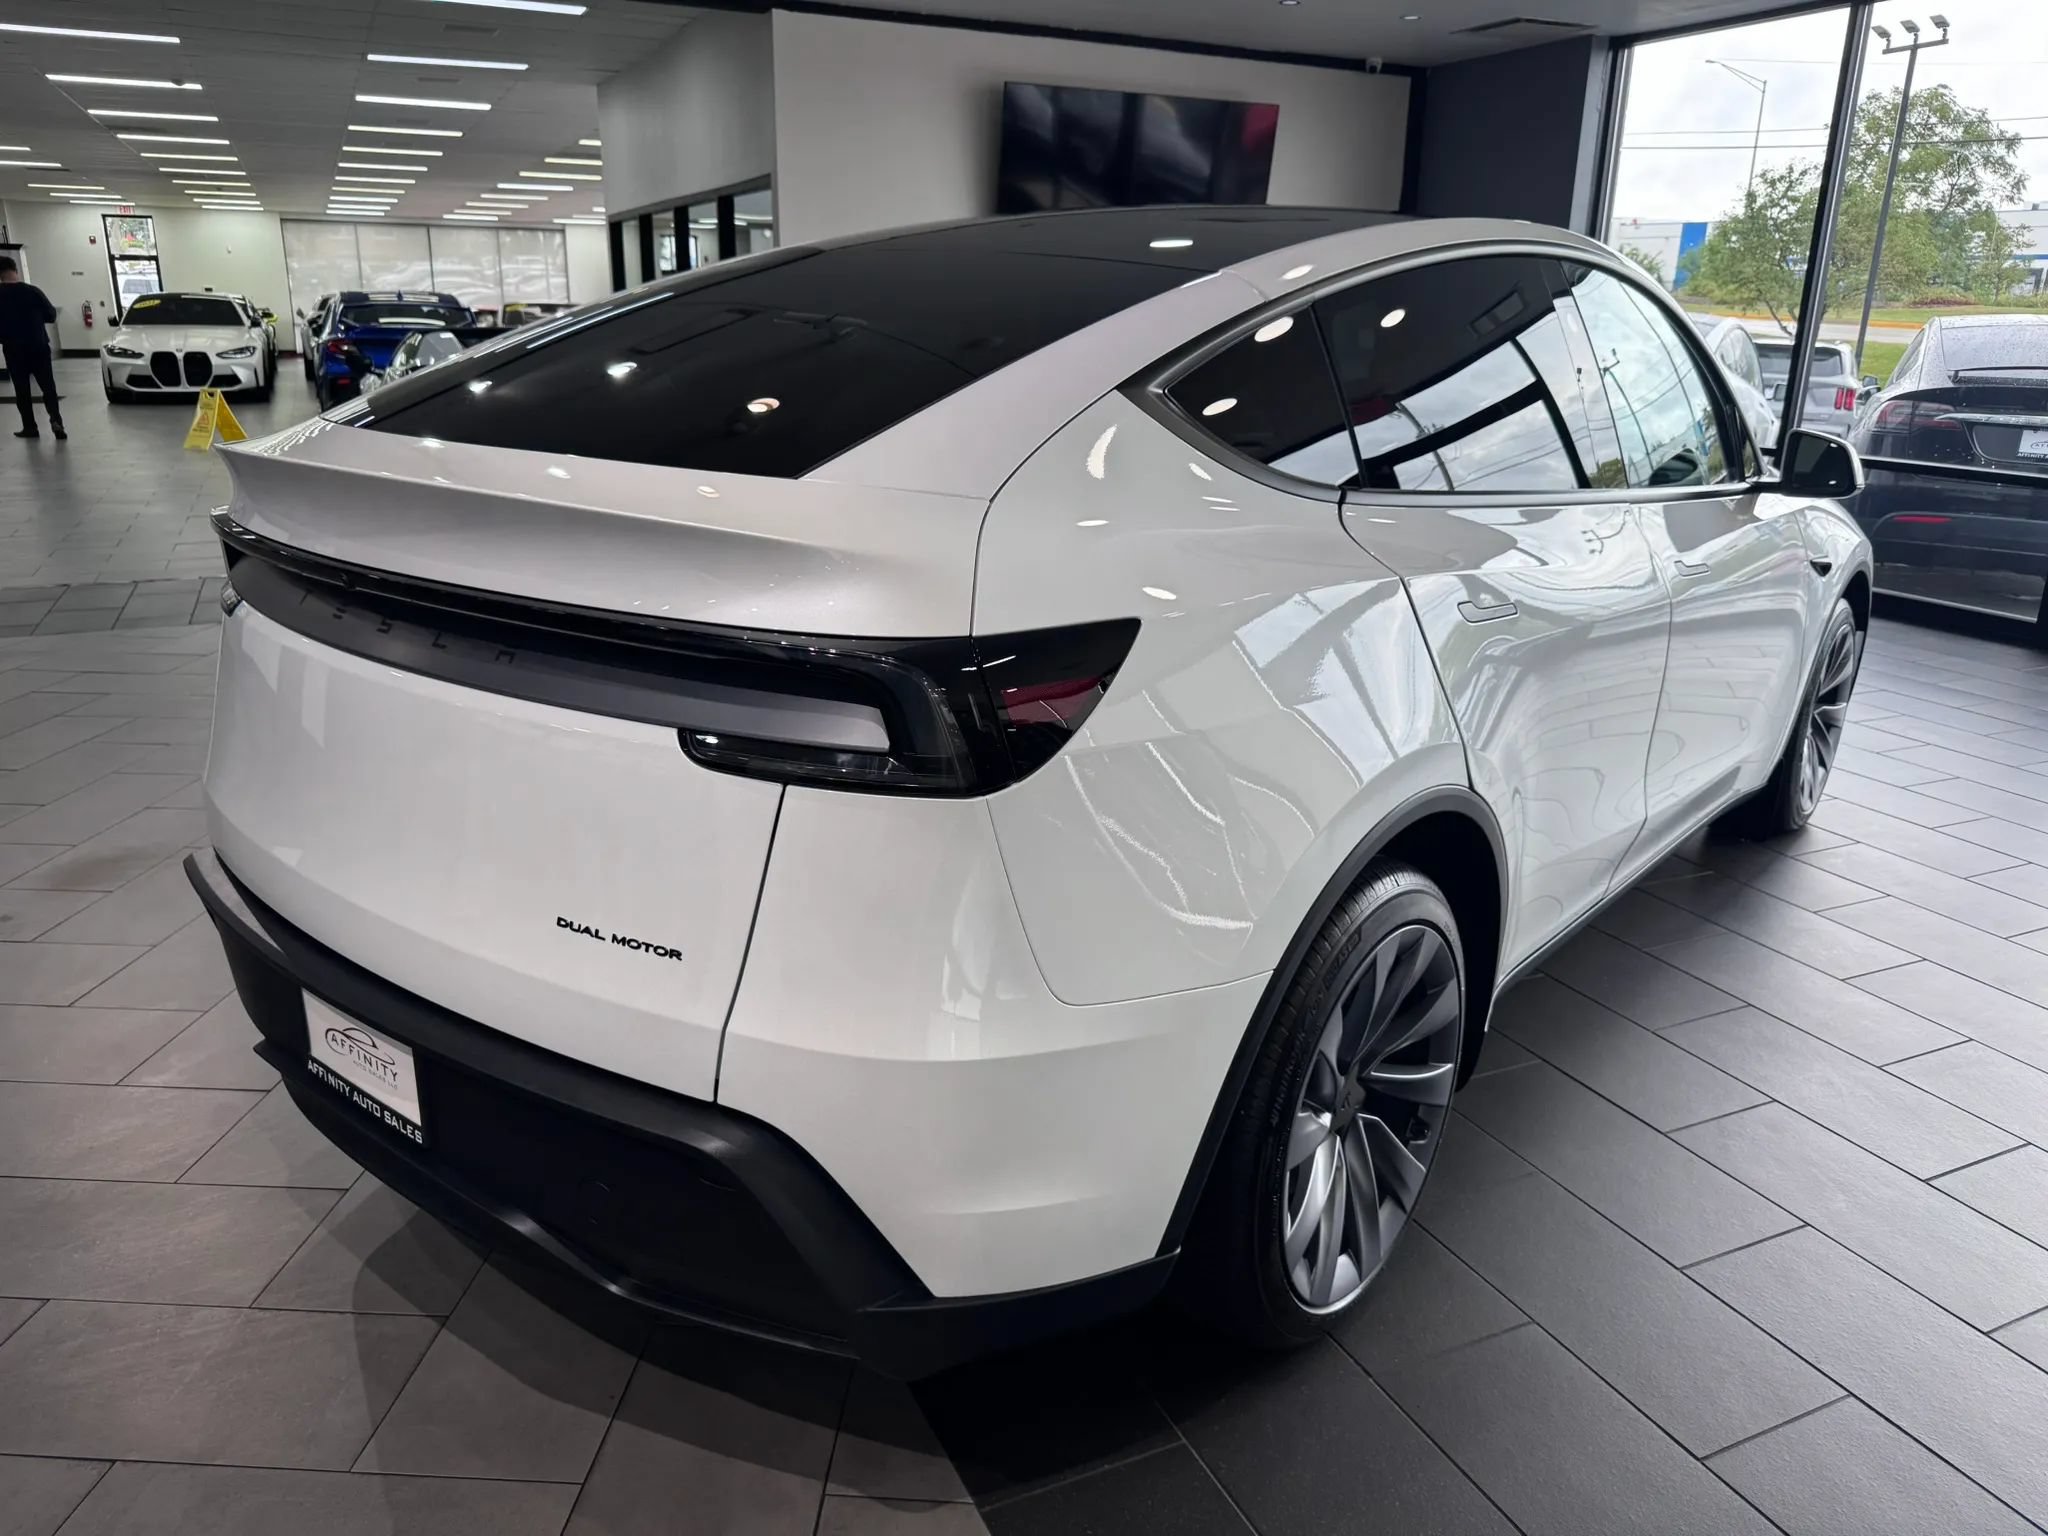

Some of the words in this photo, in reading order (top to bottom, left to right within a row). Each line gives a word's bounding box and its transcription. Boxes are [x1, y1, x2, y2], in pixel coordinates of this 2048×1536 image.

[556, 916, 606, 942] DUAL
[611, 933, 683, 961] MOTOR
[331, 1033, 398, 1082] AFFINITY
[307, 1059, 350, 1097] AFFINITY
[352, 1091, 381, 1118] AUTO
[383, 1111, 423, 1144] SALES
